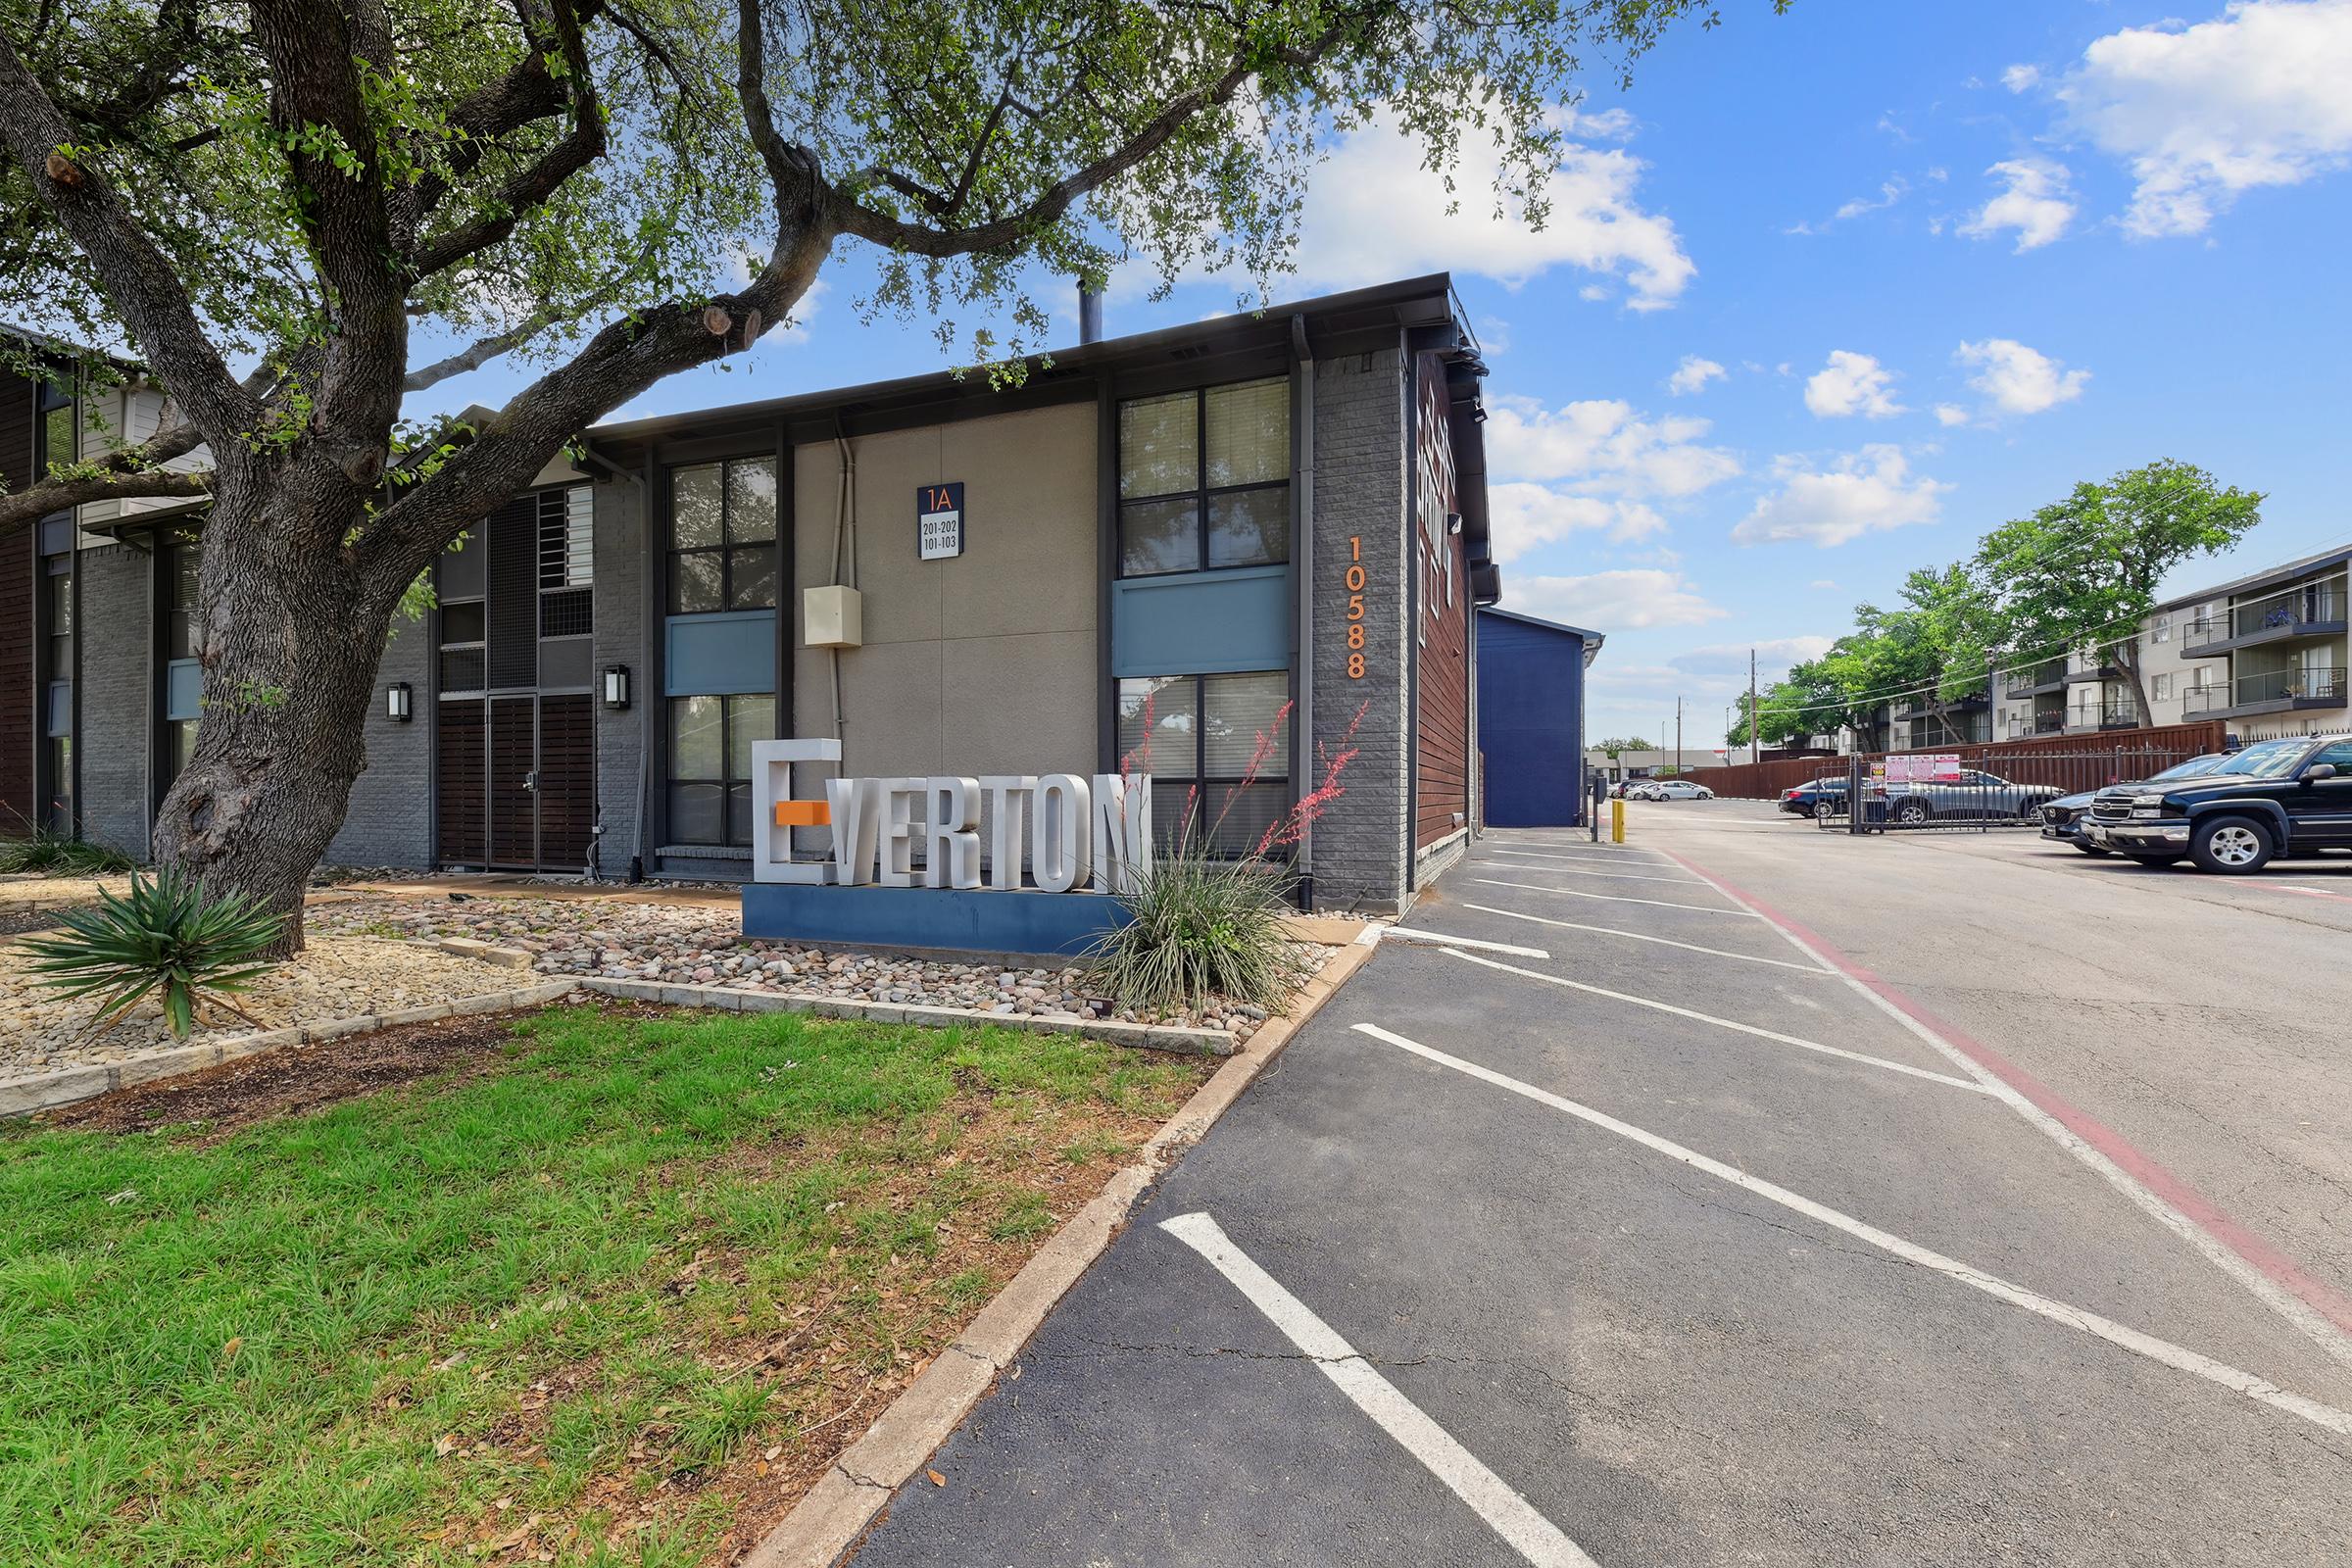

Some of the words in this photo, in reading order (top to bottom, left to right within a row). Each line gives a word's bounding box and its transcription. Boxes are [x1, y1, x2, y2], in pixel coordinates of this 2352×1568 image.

[927, 487, 953, 512] 1A
[923, 519, 956, 535] 201-202
[924, 535, 956, 550] 101-103
[1346, 536, 1365, 679] 10588
[752, 738, 1152, 896] EVERTON
